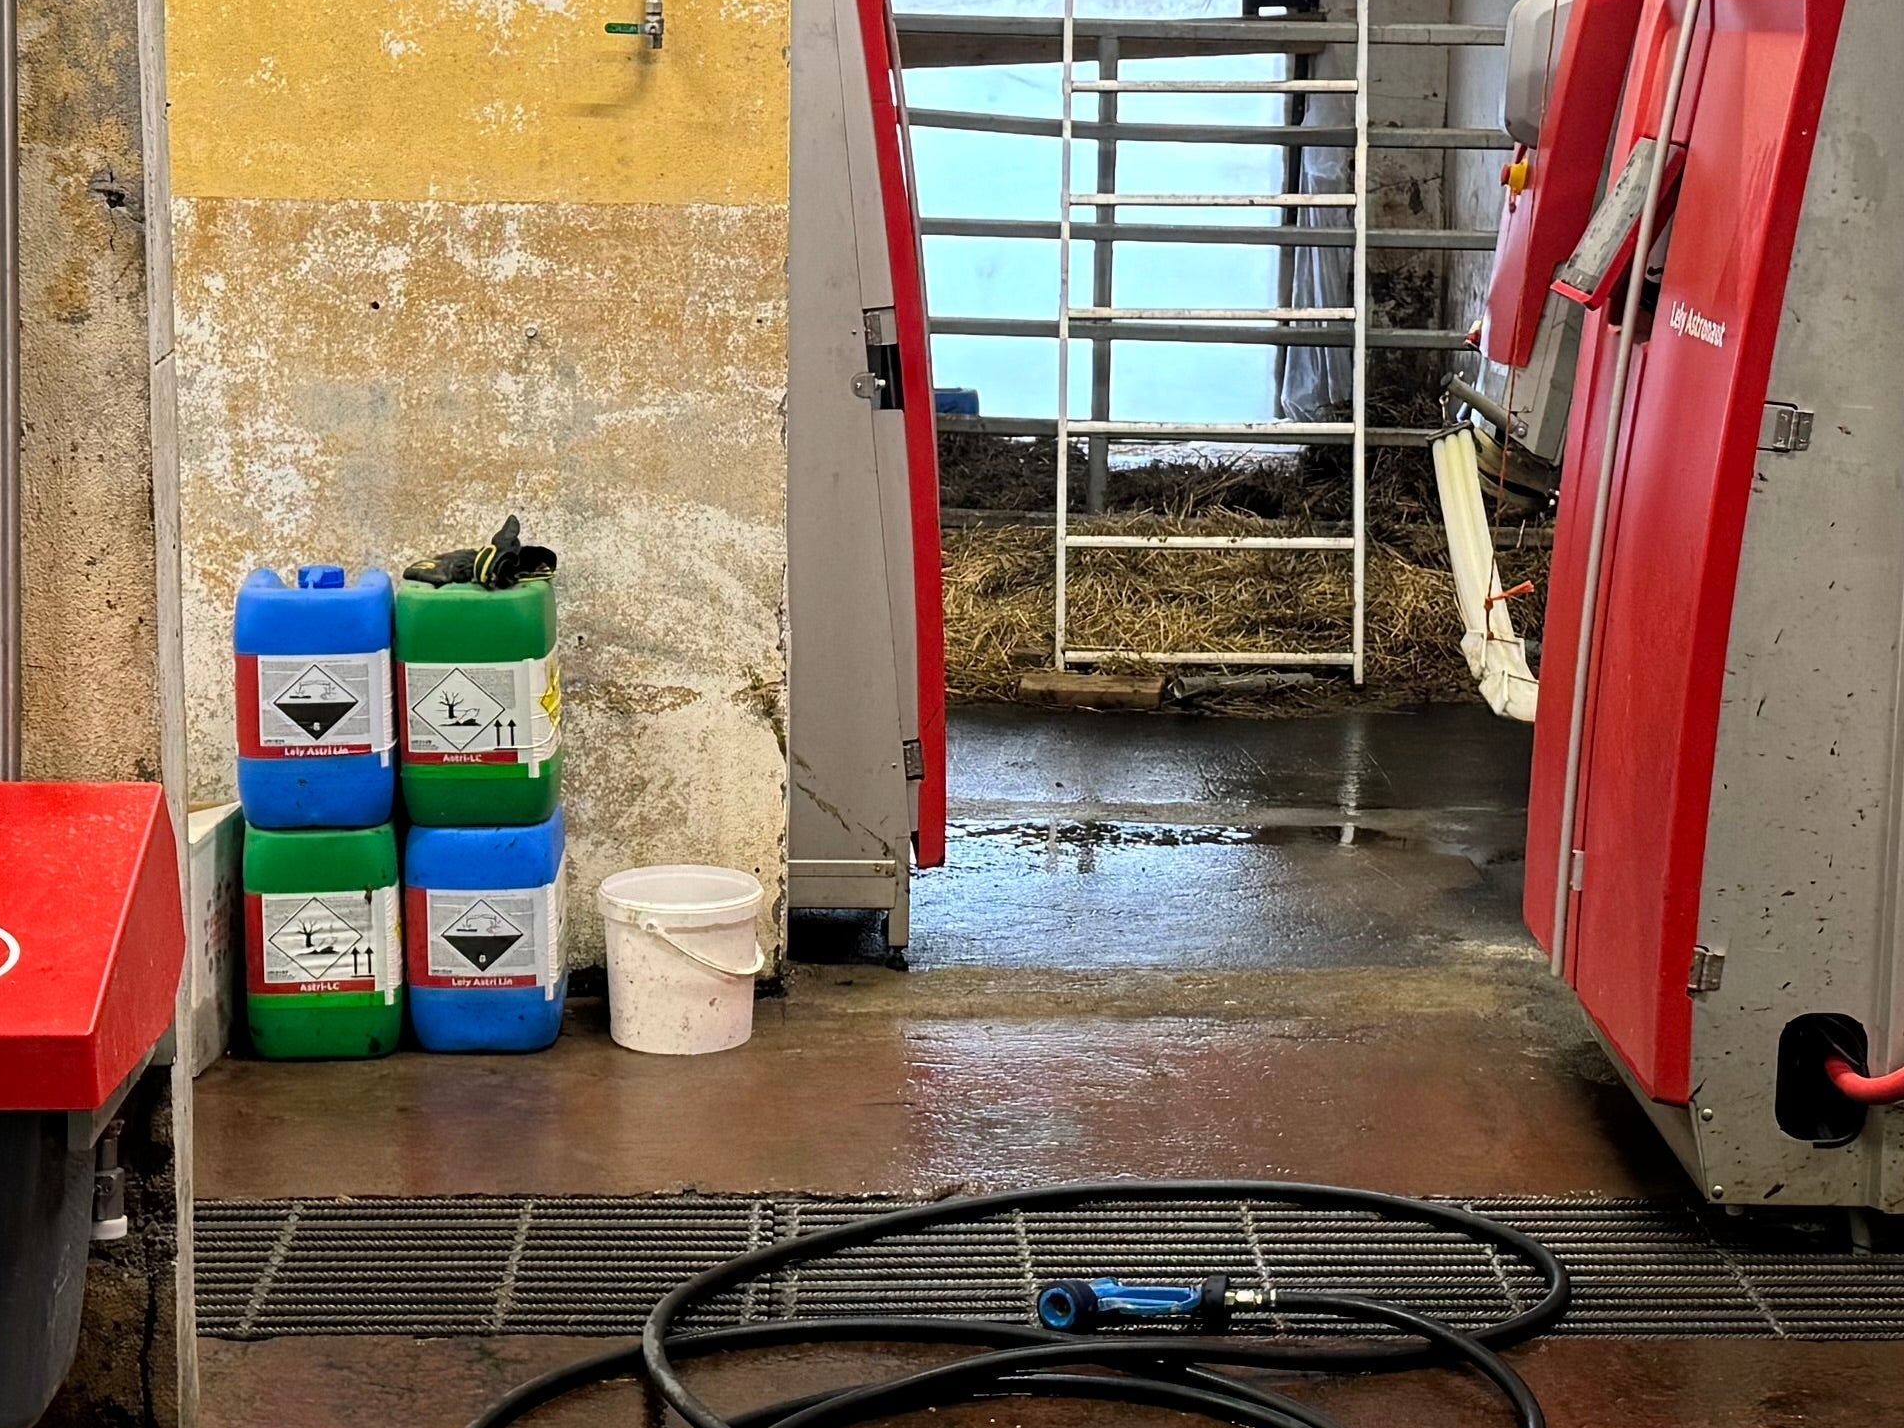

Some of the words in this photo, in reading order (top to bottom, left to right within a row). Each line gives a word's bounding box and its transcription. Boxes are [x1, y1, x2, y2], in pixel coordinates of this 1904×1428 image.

[1670, 301, 1687, 337] Lely
[284, 747, 305, 757] Lely
[451, 977, 472, 987] Lely
